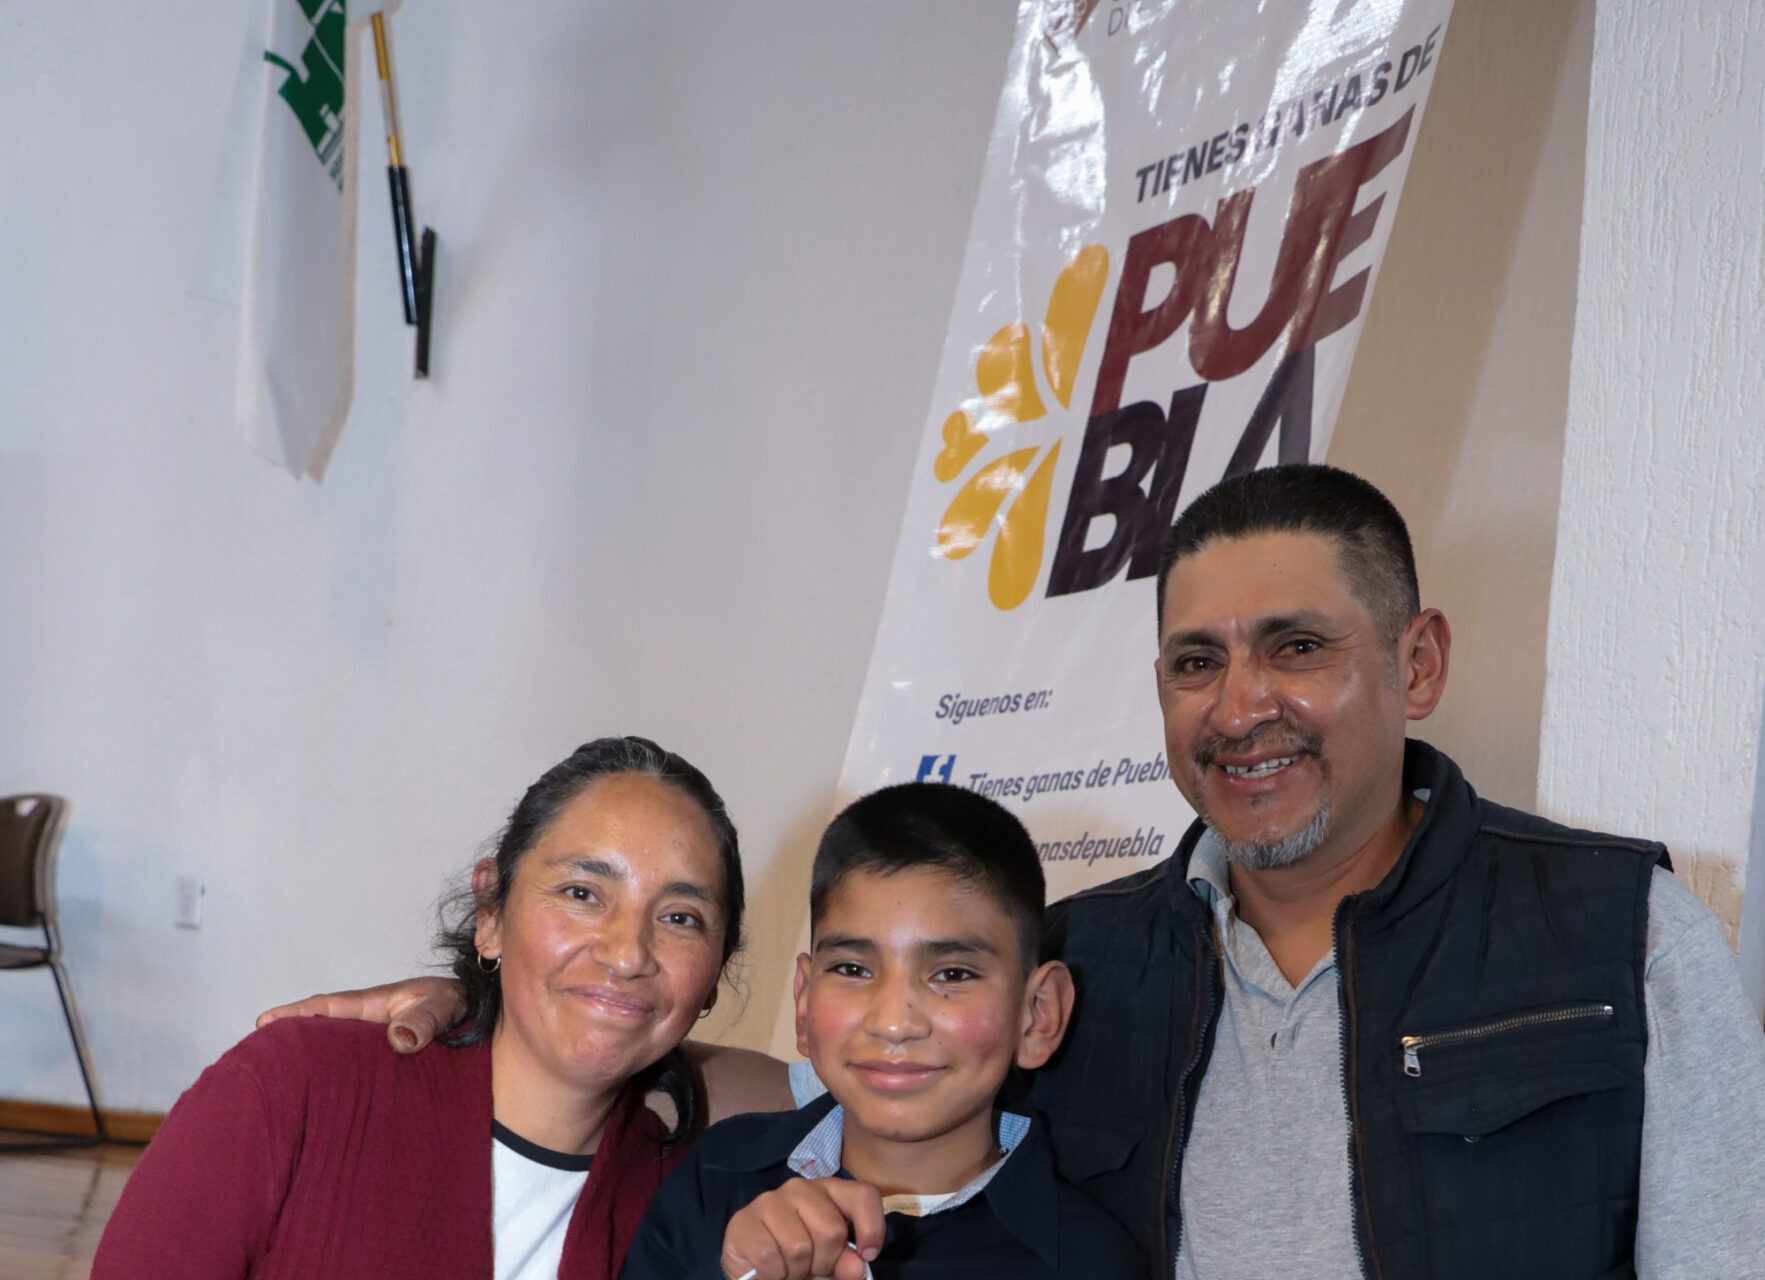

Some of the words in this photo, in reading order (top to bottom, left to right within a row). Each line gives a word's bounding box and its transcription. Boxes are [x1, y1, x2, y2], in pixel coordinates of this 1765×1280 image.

[1135, 122, 1250, 205] TIENES
[1254, 61, 1393, 153] GANAS
[1393, 24, 1442, 94] DE
[1090, 103, 1417, 415] PUE
[1024, 689, 1053, 711] en:
[969, 772, 1022, 799] Tienes
[1022, 771, 1084, 802] ganas
[1086, 759, 1111, 788] de
